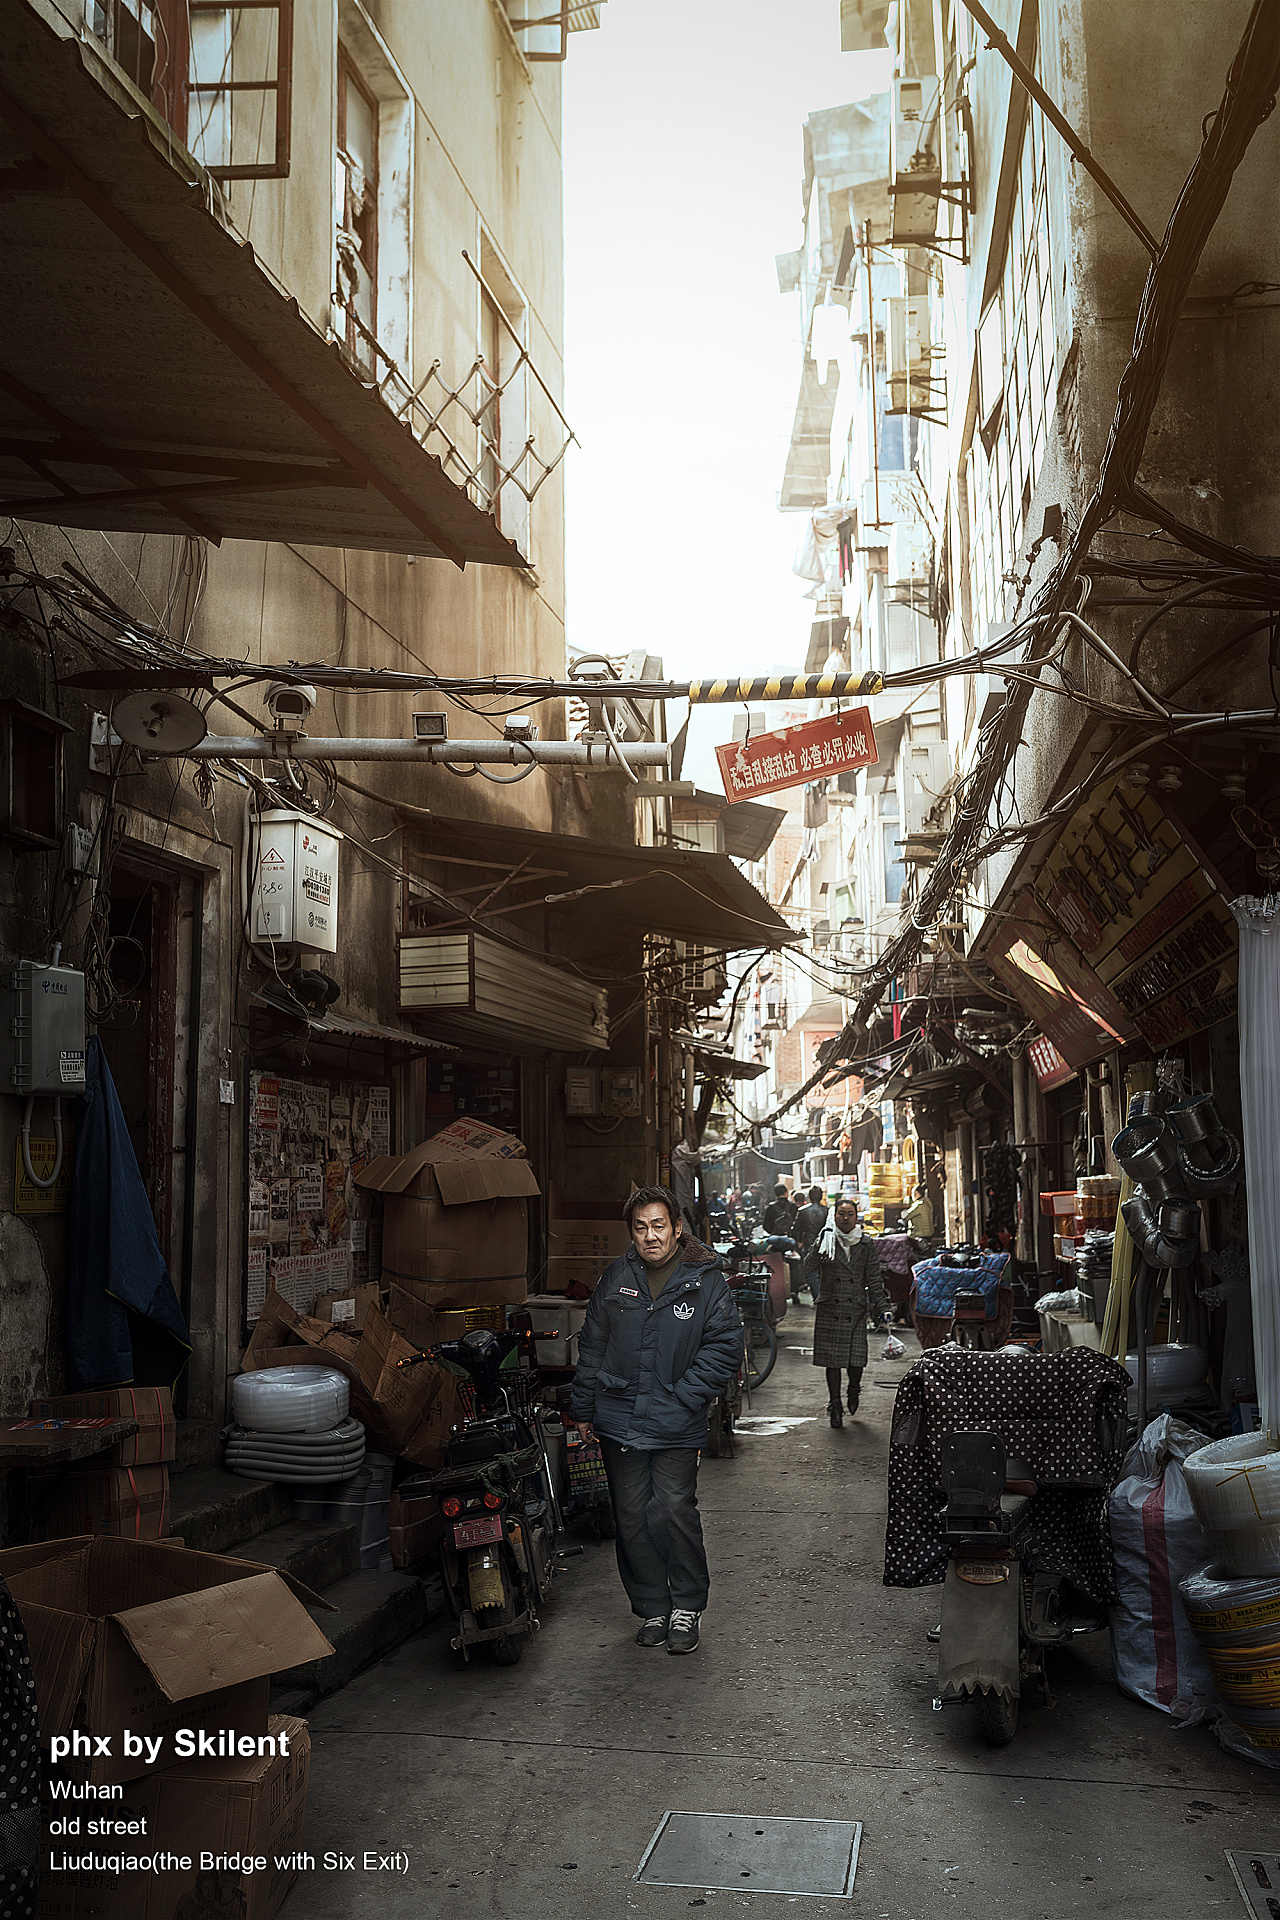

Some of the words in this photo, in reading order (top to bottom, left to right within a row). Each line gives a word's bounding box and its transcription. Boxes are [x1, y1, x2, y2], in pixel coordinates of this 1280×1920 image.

[729, 750, 799, 792] 私自乱接乱拉
[799, 731, 869, 772] 必查必罚必收
[304, 864, 332, 886] 江汉平安城市
